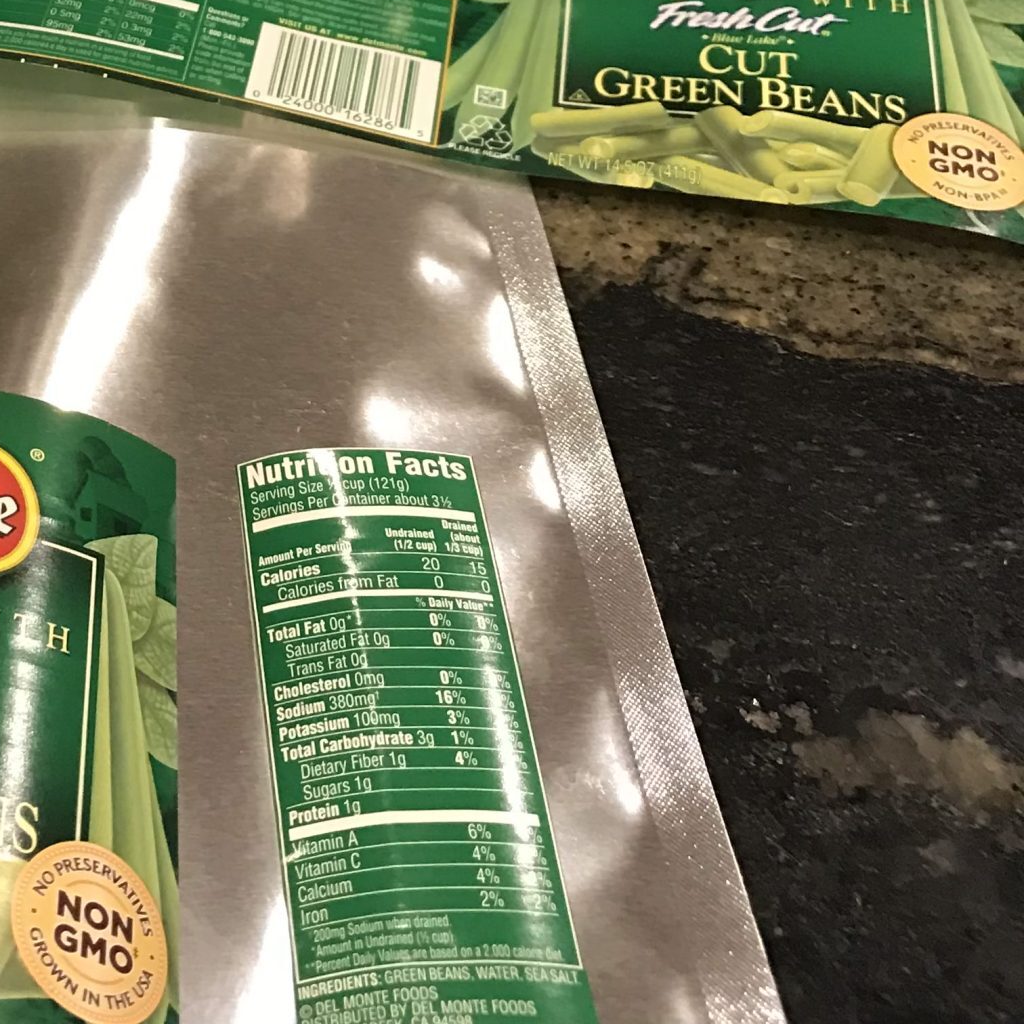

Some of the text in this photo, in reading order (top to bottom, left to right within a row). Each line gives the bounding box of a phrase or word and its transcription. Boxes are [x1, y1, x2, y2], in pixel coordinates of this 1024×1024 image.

[698, 44, 798, 79] CUT
[594, 67, 908, 124] GREEN BEANS
[282, 96, 334, 116] 24000
[345, 108, 394, 131] 16286
[416, 129, 425, 138] 5
[448, 142, 521, 162] PLEASE RECYCLE
[922, 121, 1015, 161] PRESERVATIVES
[928, 140, 996, 165] NON
[547, 151, 573, 167] NET
[578, 154, 601, 169] WT
[632, 160, 656, 176] OZ
[657, 163, 703, 185] (411g)
[246, 451, 468, 489] Nutrion Facts
[250, 484, 295, 505] Serving
[298, 480, 324, 495] Size
[342, 479, 365, 492] cup
[369, 476, 409, 492] (121g)
[252, 498, 305, 521] Servings
[307, 495, 328, 509] Per
[394, 493, 430, 506] about
[385, 528, 481, 544] Undrained (about
[441, 519, 478, 533] Drained
[258, 549, 295, 567] Amount
[296, 546, 314, 558] Per
[394, 539, 484, 557] (1/2 cup) 1/3 cup)
[260, 557, 487, 587] Calories 20 15
[277, 578, 334, 601] Calories
[376, 574, 399, 588] Fat
[434, 575, 444, 589] 0
[481, 580, 491, 593] 0
[428, 597, 454, 610] Daily
[267, 612, 451, 643] Total Fat 0%
[285, 631, 455, 659] Saturated Fat 0g 0%
[287, 652, 368, 677] Trans Fat 0g
[274, 670, 463, 702] Cholesterol 0mg 0%
[276, 699, 326, 722] Sodium
[435, 689, 467, 705] 16%
[278, 709, 470, 743] Potassium 100mg 3%
[281, 730, 474, 762] Total Carbohydrate 3g 1%
[300, 750, 478, 780] Dietary Fiber 1g 4%
[303, 775, 372, 801] Sugars 1g
[289, 799, 361, 826] Protein 1g
[291, 823, 492, 856] Vitamin A 6%
[295, 845, 496, 880] Vitamin C 4%
[32, 857, 154, 938] NO PRESERVATIVES
[297, 867, 500, 904] Calcium 4%
[56, 889, 133, 944] NON
[300, 890, 505, 926] Iron 2%
[347, 920, 384, 936] Sodium
[29, 927, 79, 995] GROWN
[81, 970, 154, 1010] IN THE USA
[297, 972, 383, 1000] INGREDIENTS:
[384, 967, 427, 984] GREEN
[524, 966, 549, 982] SEA
[316, 985, 438, 1015] DEL MONTE FOODS
[390, 999, 537, 1018] BY DEL MONTE FOODS
